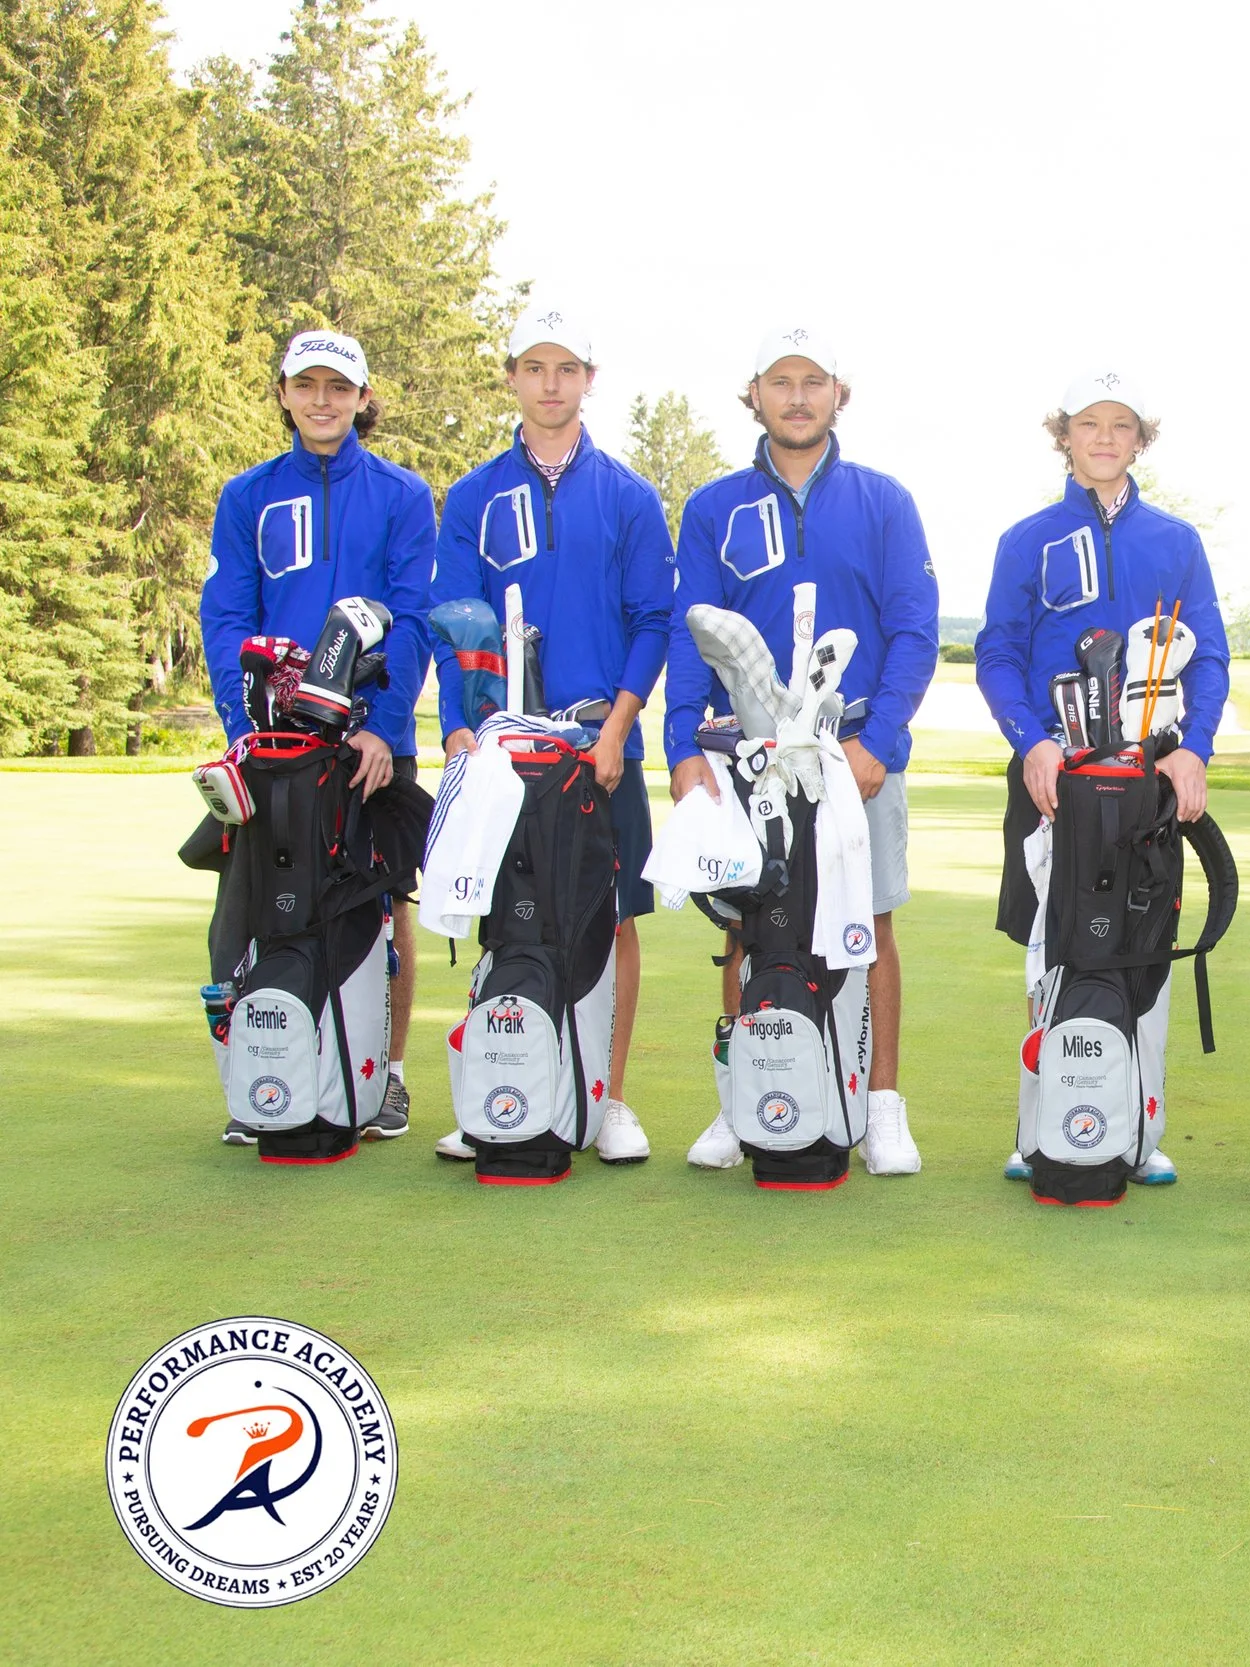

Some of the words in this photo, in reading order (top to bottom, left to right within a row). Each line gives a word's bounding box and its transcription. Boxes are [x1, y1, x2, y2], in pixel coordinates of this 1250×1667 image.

[294, 339, 358, 363] Titleist
[319, 628, 349, 680] Titleist
[1087, 676, 1102, 721] PING
[246, 1002, 287, 1030] Rennie
[486, 1010, 525, 1034] Kraik
[749, 1018, 793, 1040] Ingoglia
[1063, 1035, 1103, 1058] Miles
